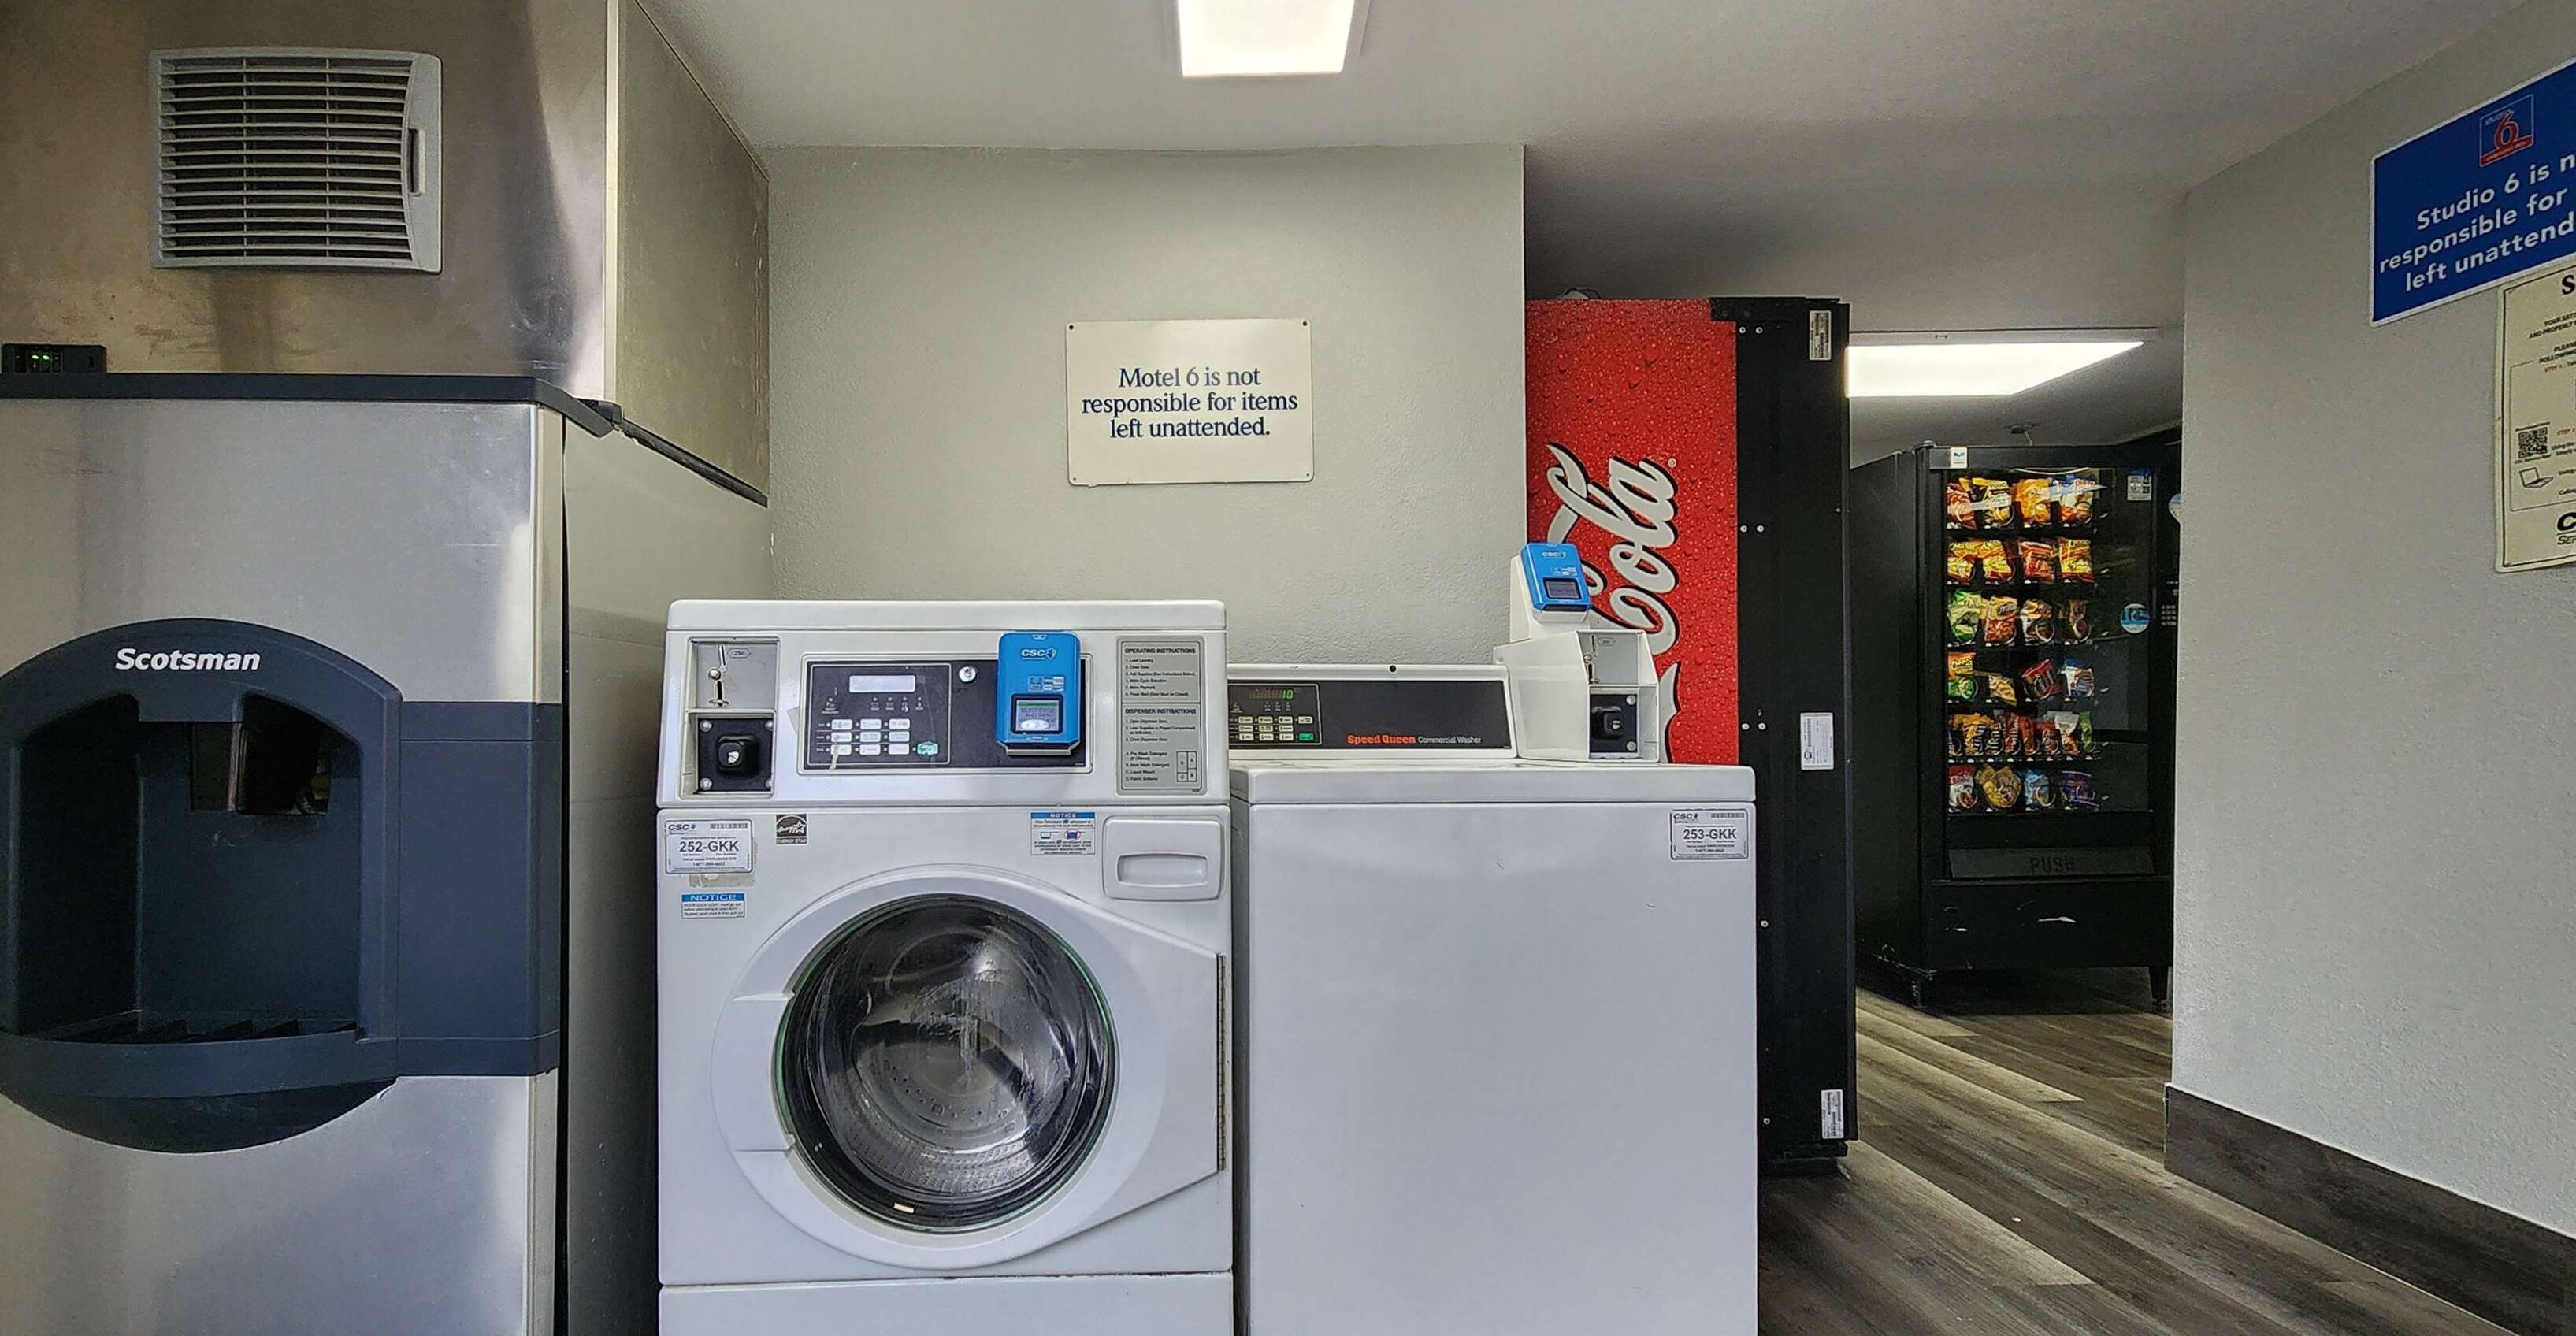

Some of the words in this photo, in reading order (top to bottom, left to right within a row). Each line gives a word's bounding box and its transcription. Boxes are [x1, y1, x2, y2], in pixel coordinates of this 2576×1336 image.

[2417, 187, 2495, 230] Studio
[2504, 173, 2519, 194] 6
[2530, 164, 2550, 185] is
[2380, 208, 2518, 273] responsible
[2526, 188, 2567, 216] for
[2405, 263, 2447, 291] left
[2455, 210, 2574, 274] unattend
[1118, 367, 1180, 388] Motel
[1186, 367, 1200, 387] 6
[1204, 366, 1220, 386] is
[1227, 367, 1261, 386] not
[1082, 393, 1201, 418] responsible
[1208, 392, 1236, 411] for
[1241, 392, 1297, 411] items
[1110, 418, 1143, 438] left
[1149, 417, 1271, 438] unattended.
[115, 648, 260, 670] Scotsman
[1022, 648, 1045, 657] CSC
[1347, 734, 1379, 745] Speed
[1382, 734, 1416, 744] Queen
[1418, 735, 1456, 744] Commercial
[1683, 828, 1737, 840] 253-GKK
[679, 840, 740, 852] 252-GKK
